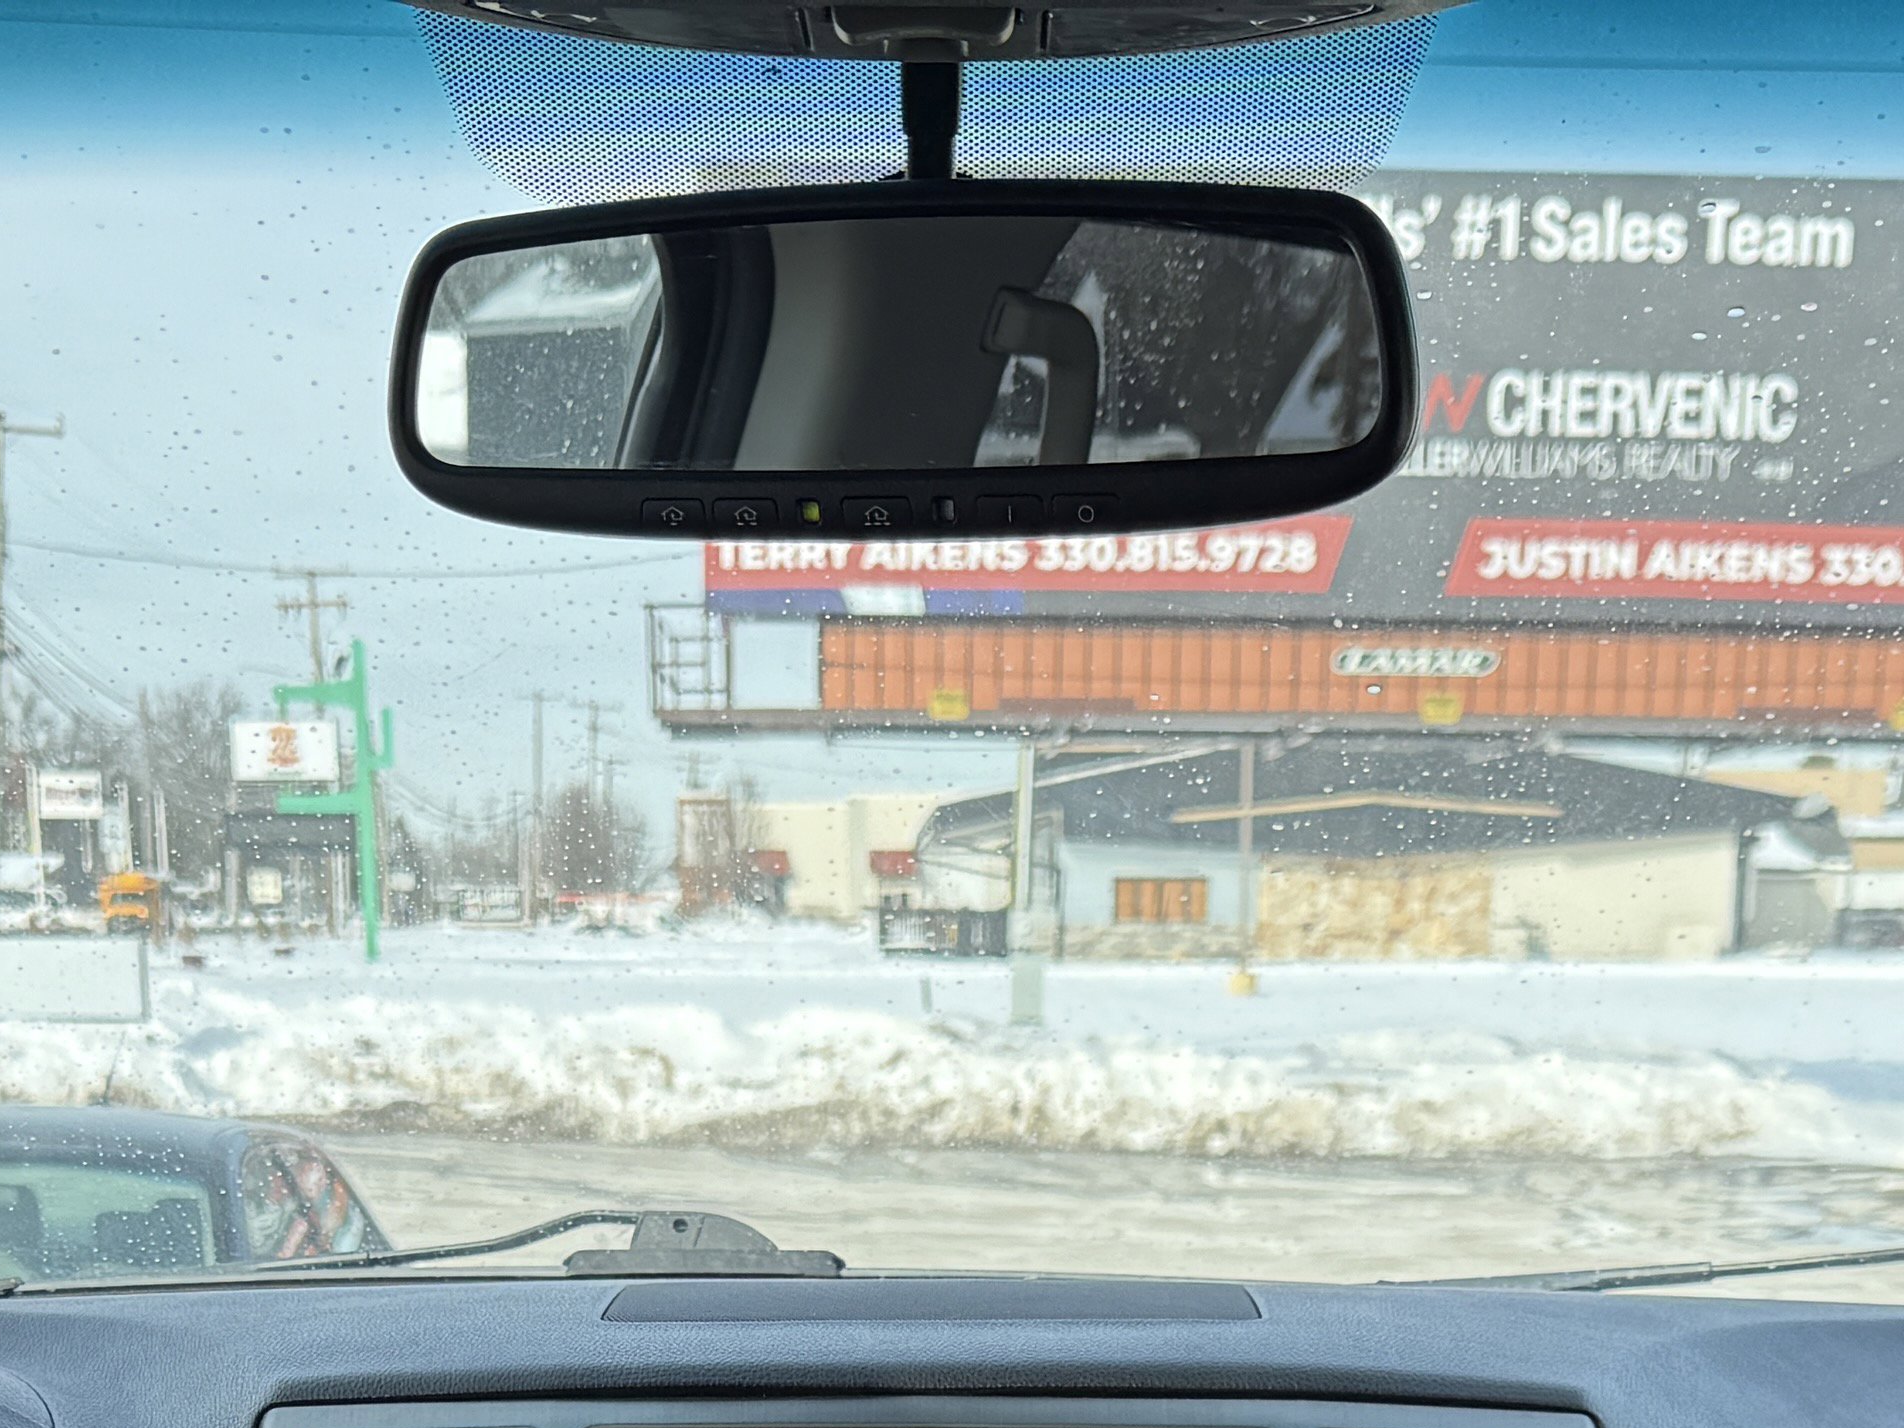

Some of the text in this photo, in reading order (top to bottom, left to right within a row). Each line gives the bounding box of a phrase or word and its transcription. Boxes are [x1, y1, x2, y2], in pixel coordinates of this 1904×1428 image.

[1451, 194, 1521, 260] #1
[1529, 196, 1688, 264] Sales
[1698, 198, 1855, 268] Team
[1487, 368, 1798, 443] CHERVENIC
[717, 531, 1319, 574] TERRY AIKENS 330.815.9728
[1477, 537, 1639, 581] JUSTIN
[1644, 540, 1814, 586] AIKENS
